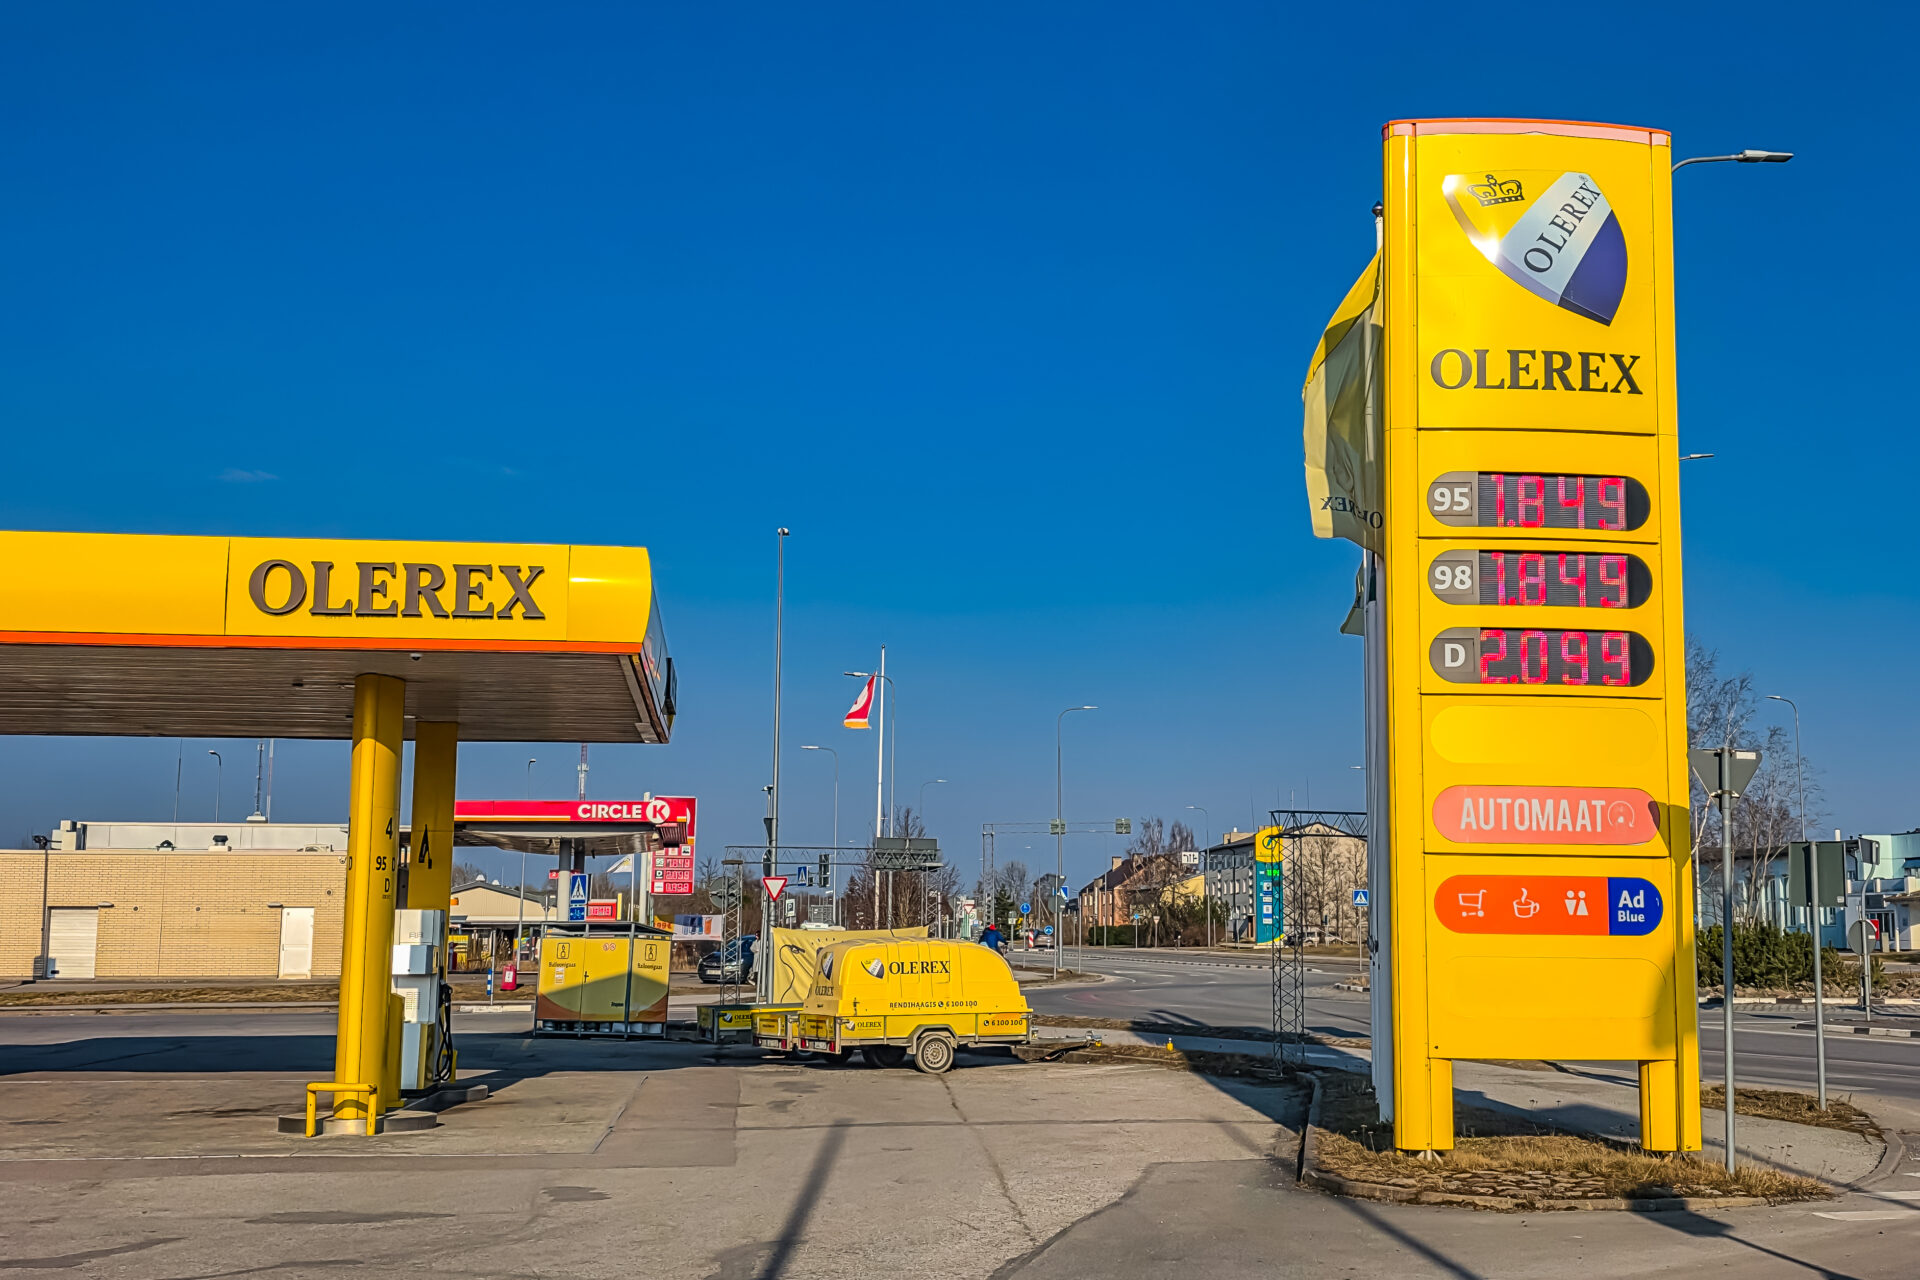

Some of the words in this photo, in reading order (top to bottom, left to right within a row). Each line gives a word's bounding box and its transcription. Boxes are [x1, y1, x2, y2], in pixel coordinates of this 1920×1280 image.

[1523, 182, 1601, 273] OLEREX
[1430, 348, 1643, 395] OLEREX
[1433, 487, 1469, 512] 95
[1490, 474, 1626, 531] 1.849
[249, 559, 545, 620] OLEREX
[1434, 565, 1472, 590] 98
[1491, 552, 1628, 608] 1.849
[1444, 643, 1466, 668] D
[1480, 629, 1631, 686] 2.099
[577, 804, 642, 819] CIRCLE
[652, 804, 667, 821] K
[1460, 798, 1606, 833] AUTOMAAT
[385, 817, 393, 840] 4
[375, 856, 387, 871] 95
[384, 878, 391, 893] D
[1618, 889, 1645, 908] Ad
[1617, 910, 1645, 923] Blue
[889, 961, 950, 975] OLEREX
[815, 985, 834, 997] OLEREX
[889, 1001, 937, 1009] RENDIHAAGIS
[965, 1000, 978, 1008] 100
